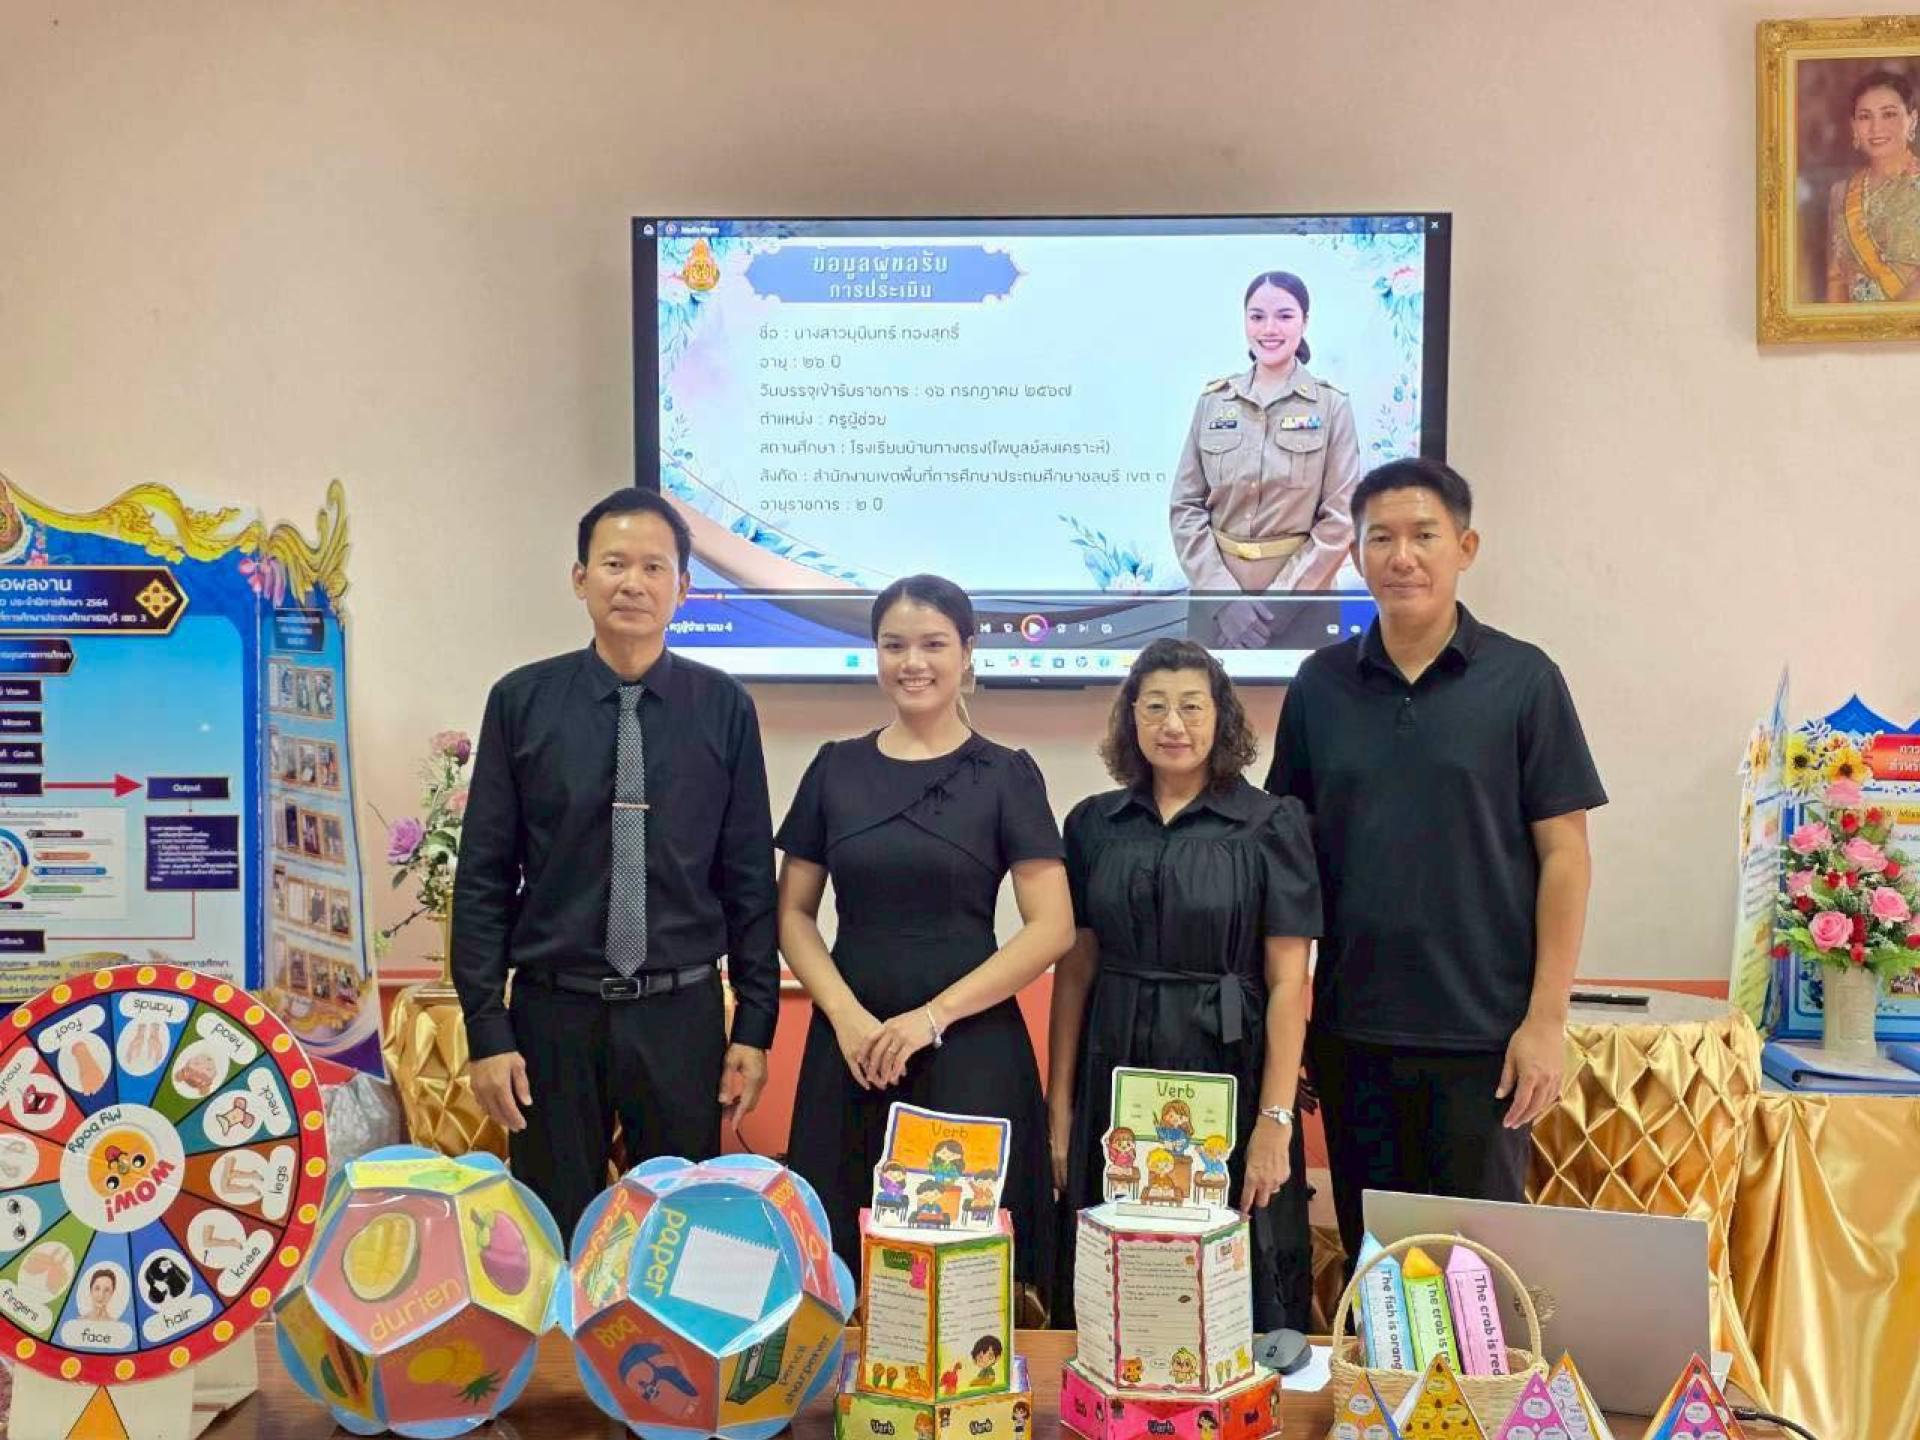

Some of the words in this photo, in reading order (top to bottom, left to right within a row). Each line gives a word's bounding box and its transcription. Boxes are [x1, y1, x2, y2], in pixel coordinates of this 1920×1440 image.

[829, 279, 933, 299] การประเมิน
[759, 357, 788, 372] อายุ
[132, 998, 175, 1017] hands
[54, 1020, 84, 1041] foot
[213, 1023, 244, 1053] head
[259, 1084, 281, 1117] neck
[1156, 1081, 1196, 1099] Verb
[99, 1108, 123, 1127] My
[67, 1121, 101, 1155] body
[931, 1121, 969, 1138] Verb
[271, 1165, 289, 1196] legs
[231, 1245, 262, 1279] knee
[643, 1206, 688, 1299] paper
[1380, 1269, 1392, 1292] The
[1475, 1274, 1488, 1302] The
[1426, 1280, 1439, 1305] The
[1, 1286, 39, 1322] fingers
[1384, 1294, 1396, 1318] fish
[162, 1306, 193, 1328] hair
[1387, 1320, 1400, 1331] is
[1431, 1308, 1444, 1336] crab
[1480, 1305, 1494, 1337] crab
[80, 1328, 112, 1344] face
[1438, 1338, 1452, 1349] is
[1486, 1338, 1499, 1350] is
[1390, 1334, 1403, 1370] orang
[870, 1419, 895, 1436] Verb
[969, 1418, 993, 1436] Verb
